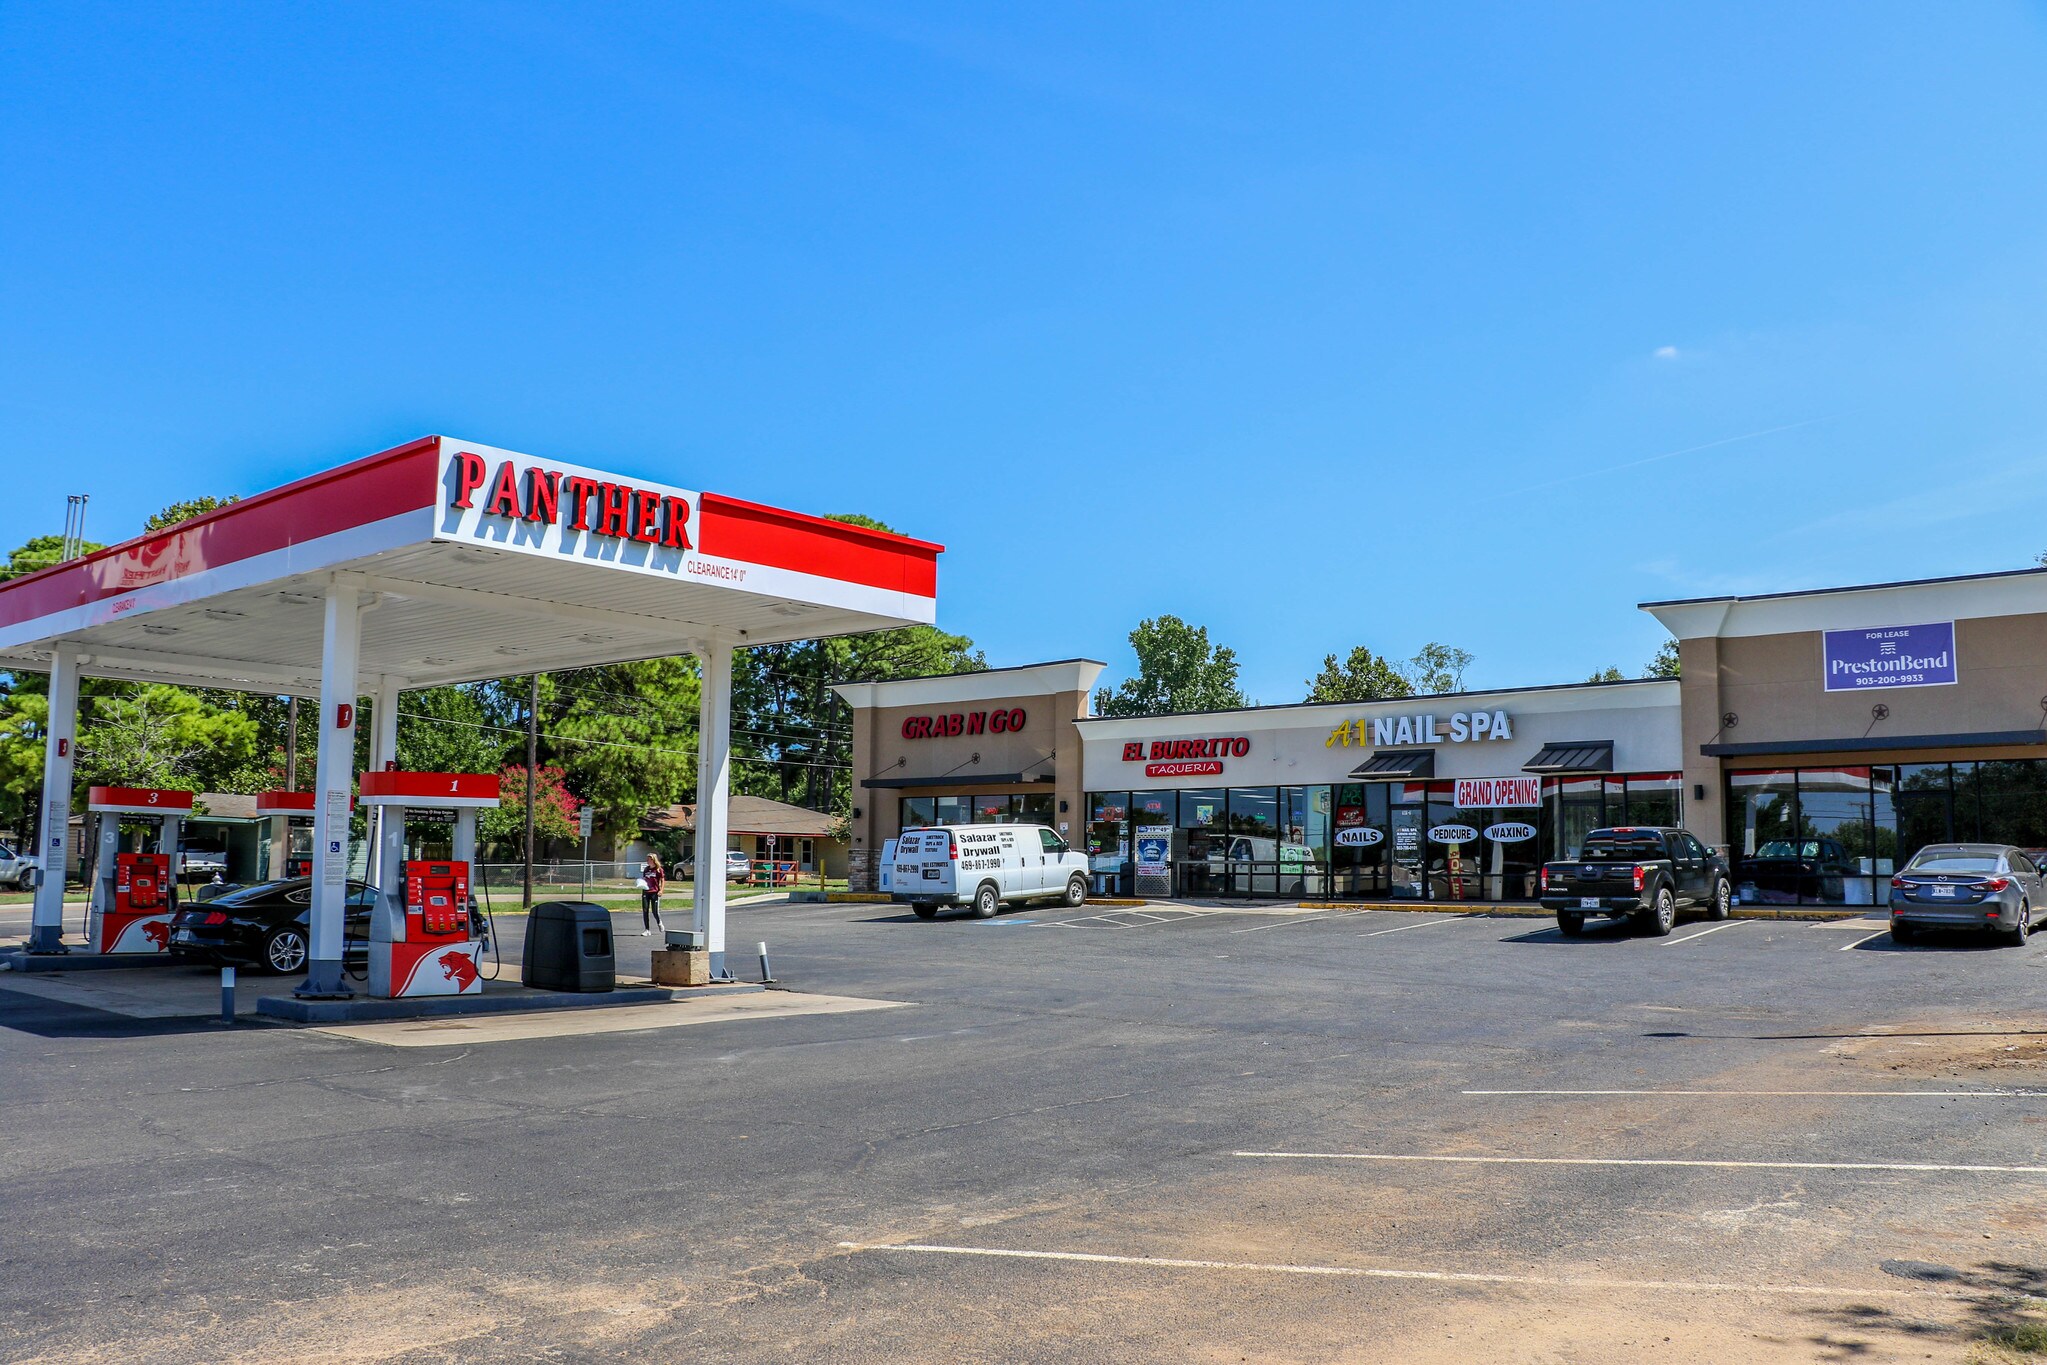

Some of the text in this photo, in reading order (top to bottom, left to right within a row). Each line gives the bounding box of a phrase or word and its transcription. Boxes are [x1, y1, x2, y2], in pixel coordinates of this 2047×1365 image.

[450, 452, 693, 550] PANTHER
[687, 560, 730, 579] CLEARANCE
[1884, 630, 1910, 638] LEASE
[1832, 651, 1948, 675] PrestonBend
[1856, 674, 1924, 686] 903-200-9933
[901, 708, 1026, 739] GRAB N GO
[1325, 710, 1512, 748] A1 NAIL SPA
[1122, 737, 1250, 761] EL BURRITO
[1150, 763, 1217, 775] TAQUERIA
[449, 780, 459, 792] 1
[148, 792, 159, 804] 3
[1459, 779, 1538, 806] GRAND OPENING
[105, 832, 115, 843] 3
[960, 834, 996, 843] Salazar
[1342, 831, 1378, 842] NAILS
[1434, 829, 1471, 839] PEDICURE
[1491, 827, 1529, 838] WAXING
[388, 832, 397, 847] 1
[902, 836, 920, 845] Salazar
[900, 845, 919, 854] Drywall
[963, 846, 1001, 857] Drywall
